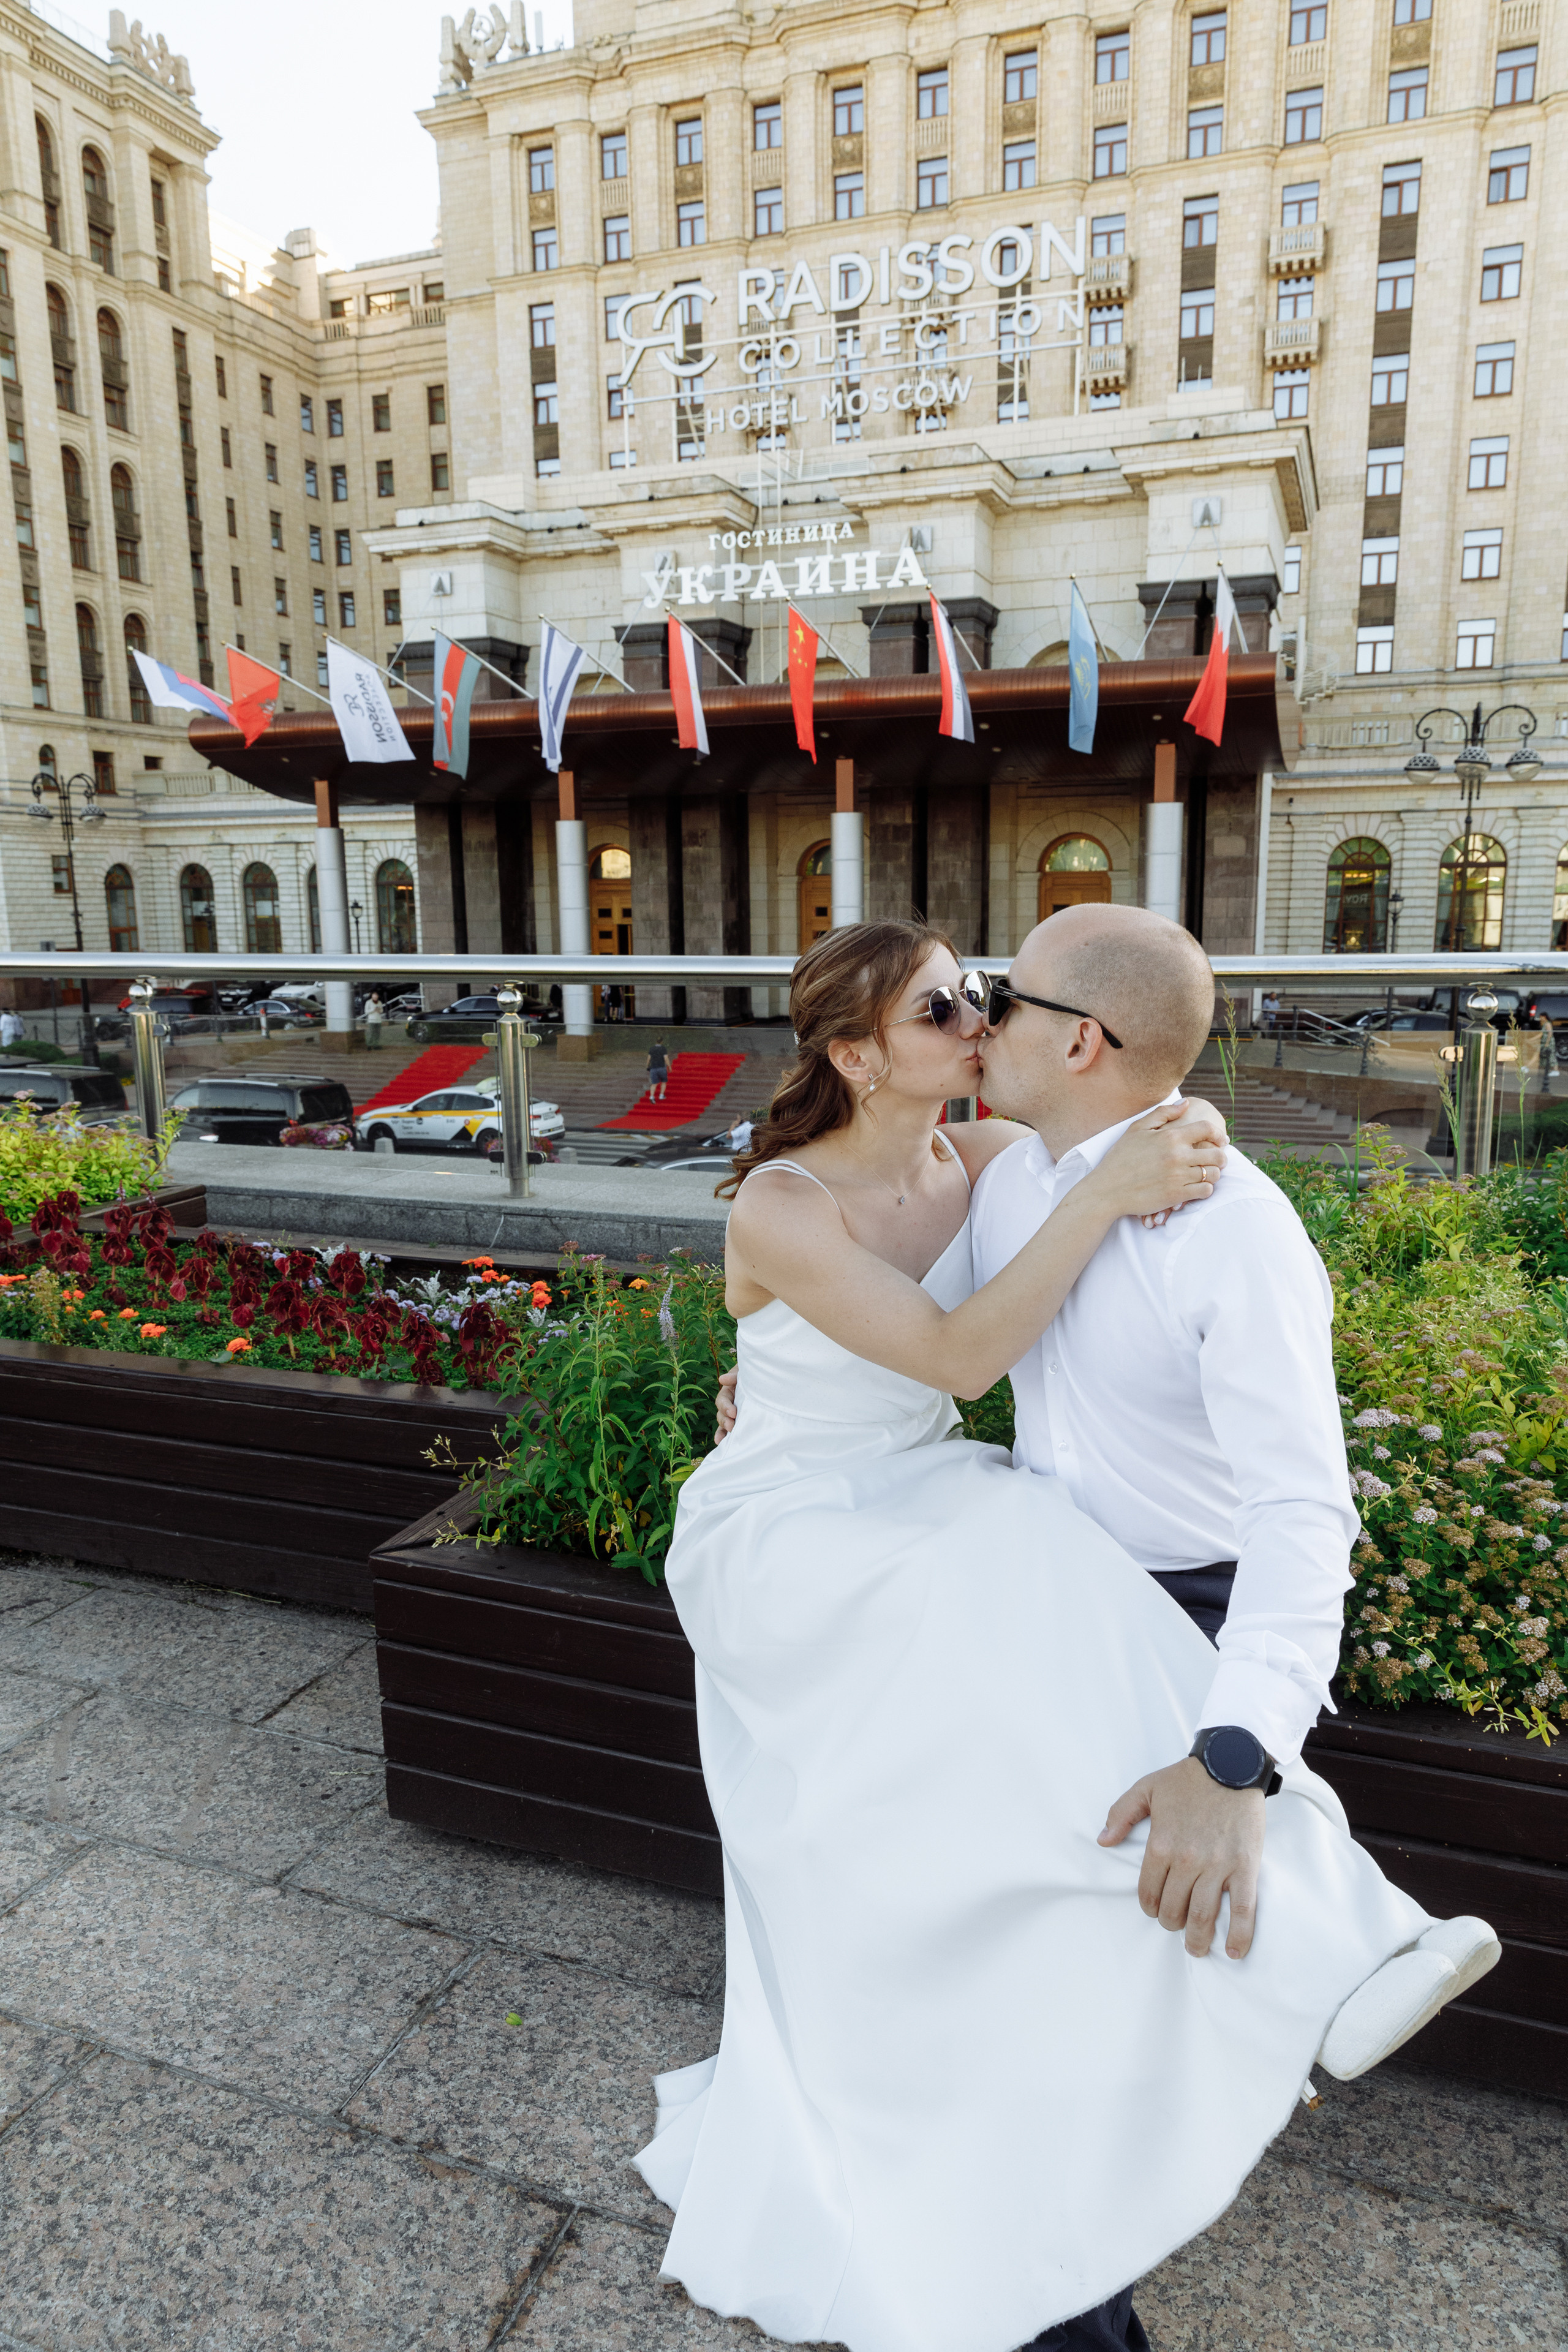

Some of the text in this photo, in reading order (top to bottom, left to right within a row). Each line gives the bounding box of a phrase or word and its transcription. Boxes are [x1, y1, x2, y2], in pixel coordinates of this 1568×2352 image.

[738, 216, 1086, 326] RADISSON
[739, 297, 1085, 375] COLLECTION
[706, 375, 973, 434] HOTEL MOSCOW
[708, 521, 855, 551] ГОСТИНИЦА
[641, 546, 929, 609] УКРАИНА
